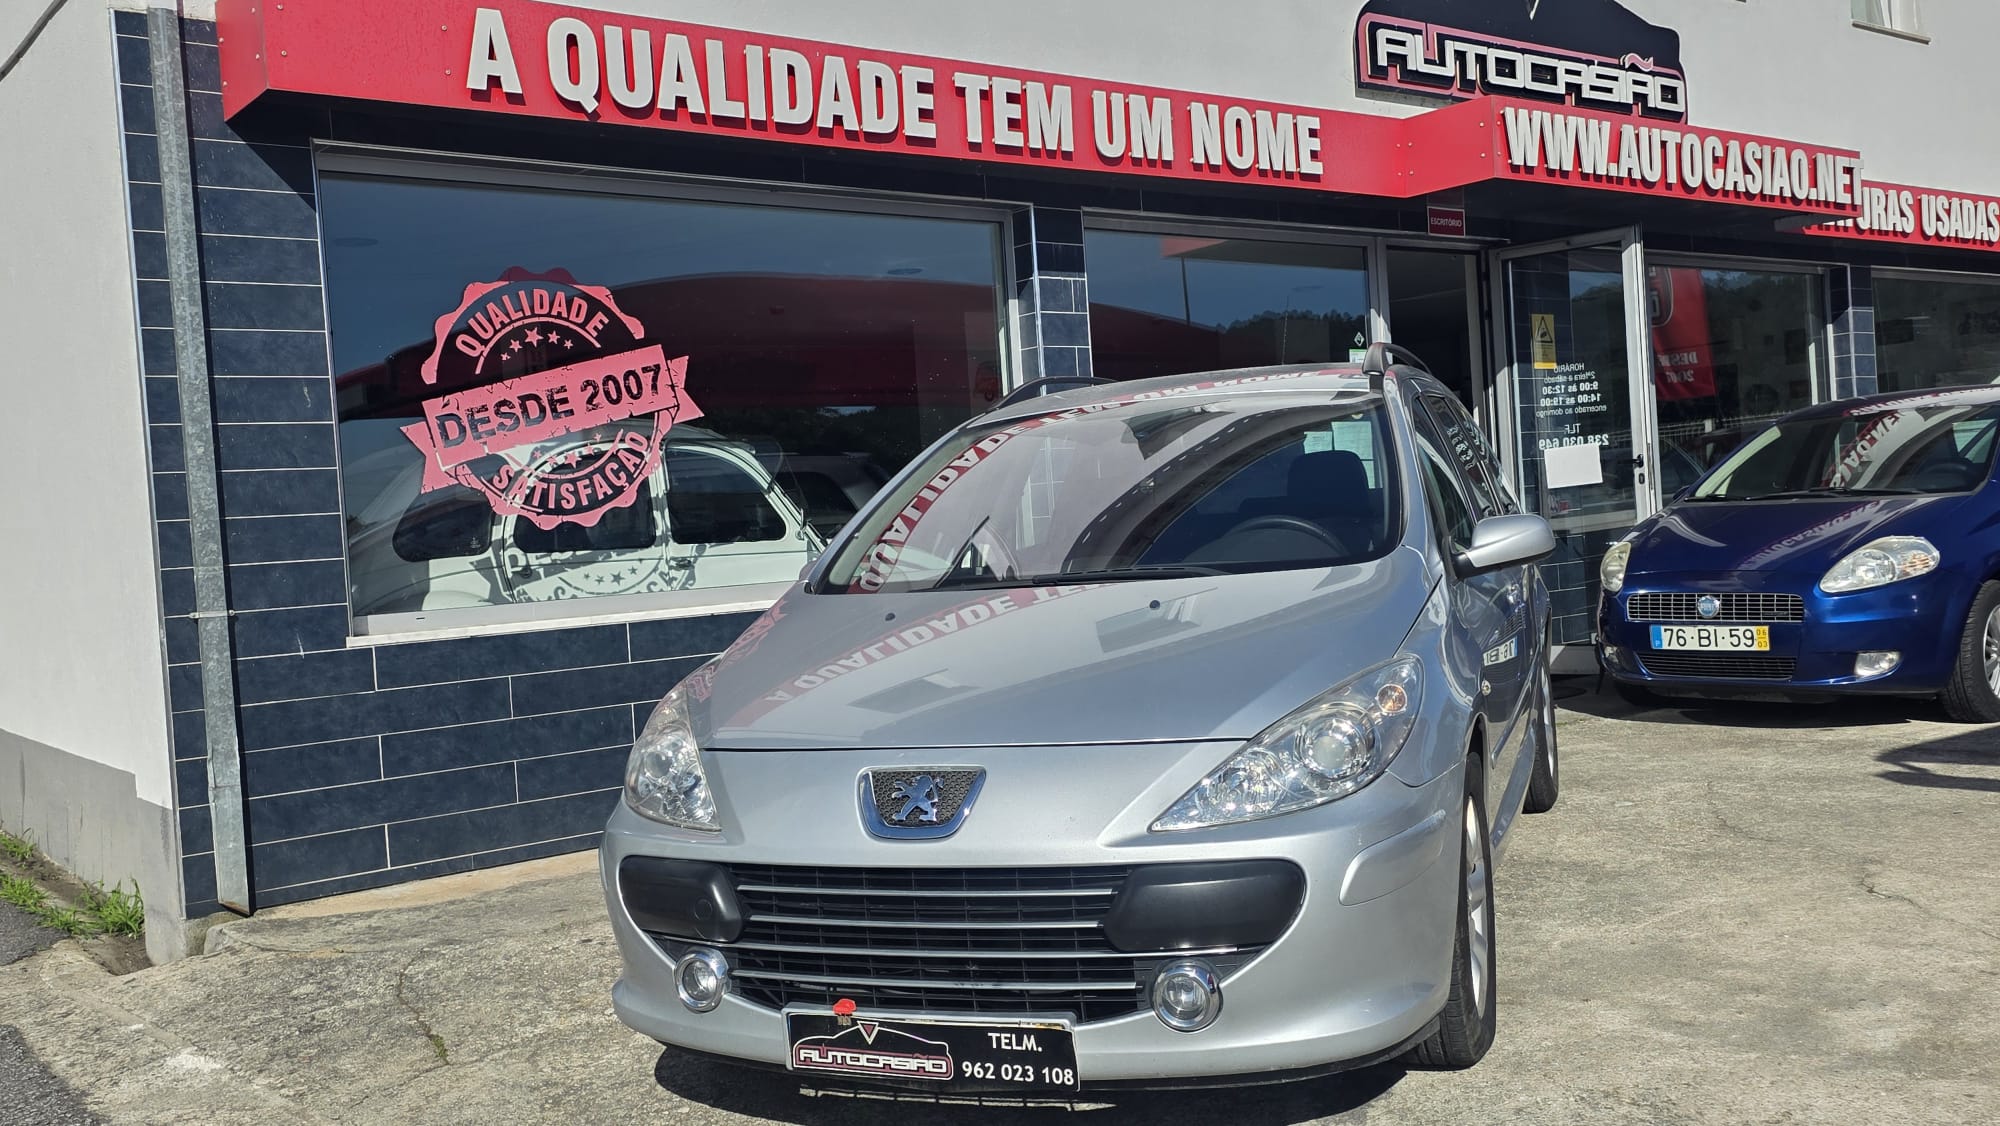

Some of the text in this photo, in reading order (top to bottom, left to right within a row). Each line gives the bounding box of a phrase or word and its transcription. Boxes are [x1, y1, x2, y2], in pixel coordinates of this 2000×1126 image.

[466, 7, 1323, 175] A QUALIDADE TEM UM NOME
[1376, 27, 1685, 113] AUTOCASIÃO
[1503, 106, 1864, 206] WWW.AUTOCASIAO.NET
[1918, 193, 2000, 243] USADAS
[455, 288, 610, 359] QUALIDADE
[435, 363, 663, 449] DESDE 2007
[962, 1061, 1074, 1086] 962 023 108
[987, 1032, 1043, 1052] TELM.
